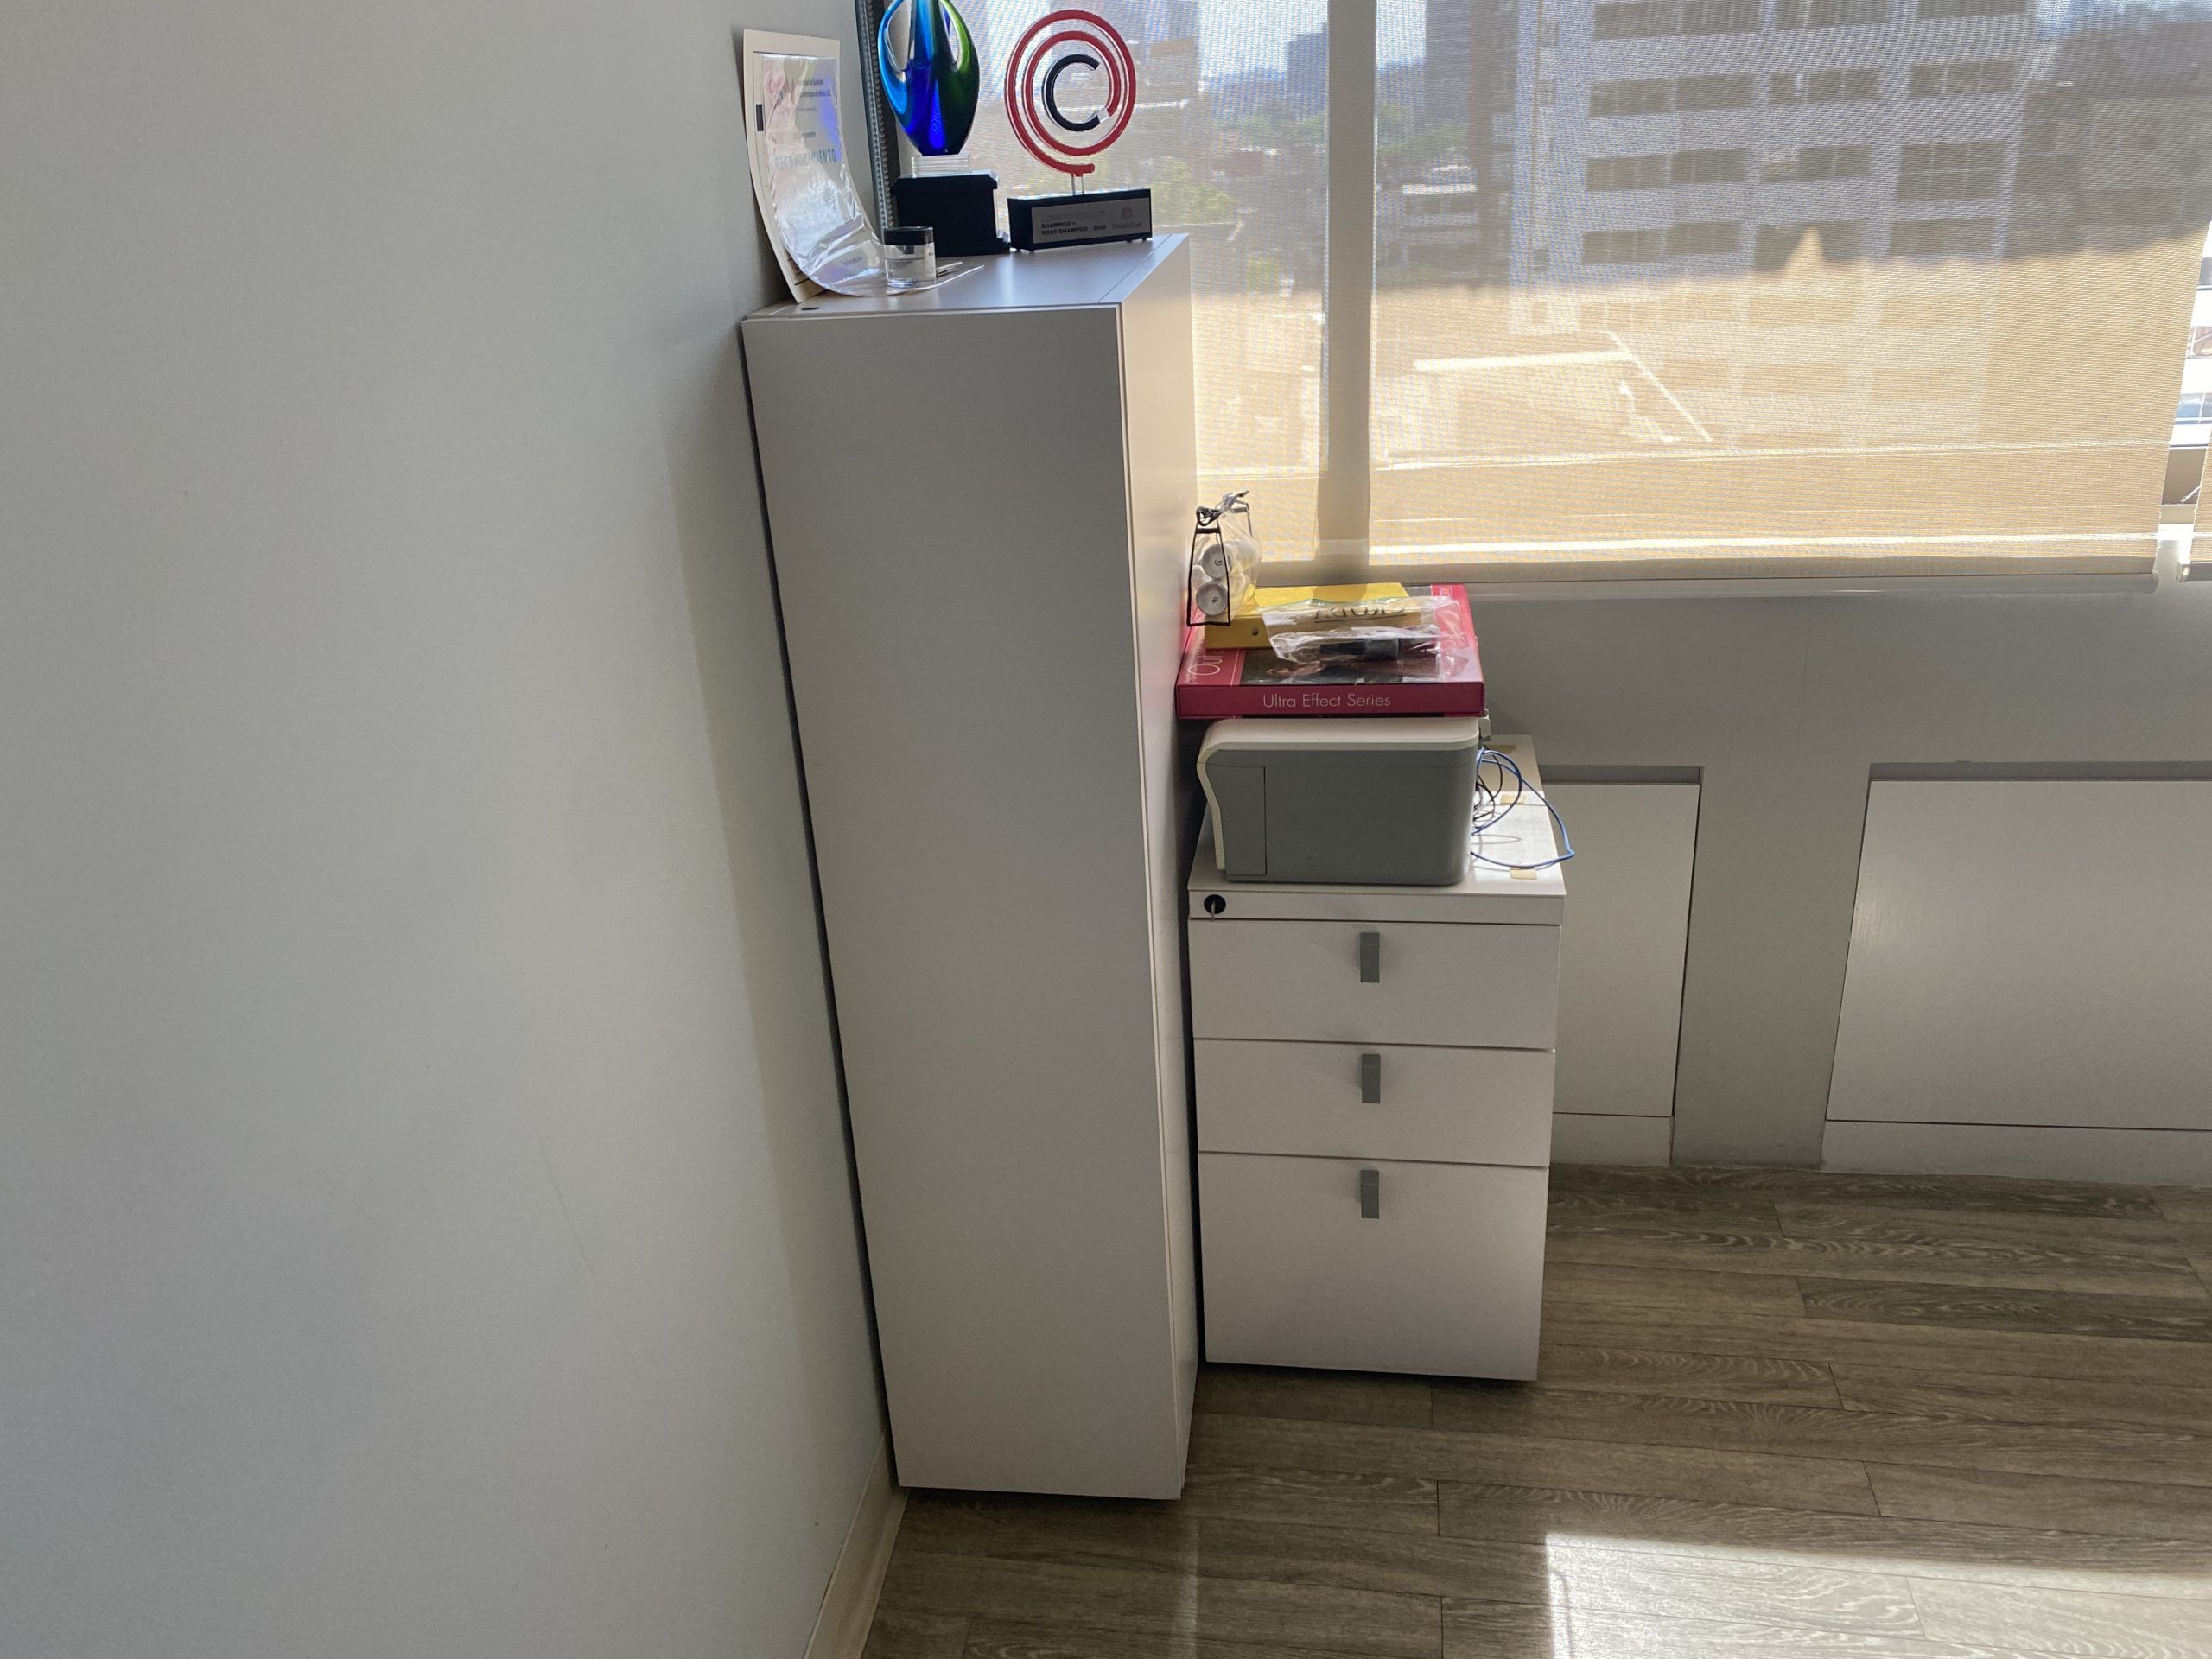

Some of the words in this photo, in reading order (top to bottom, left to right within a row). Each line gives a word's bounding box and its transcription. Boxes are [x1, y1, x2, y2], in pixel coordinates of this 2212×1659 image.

[1262, 693, 1296, 708] Ultra
[1302, 692, 1342, 708] Effect
[1347, 693, 1391, 707] Series
